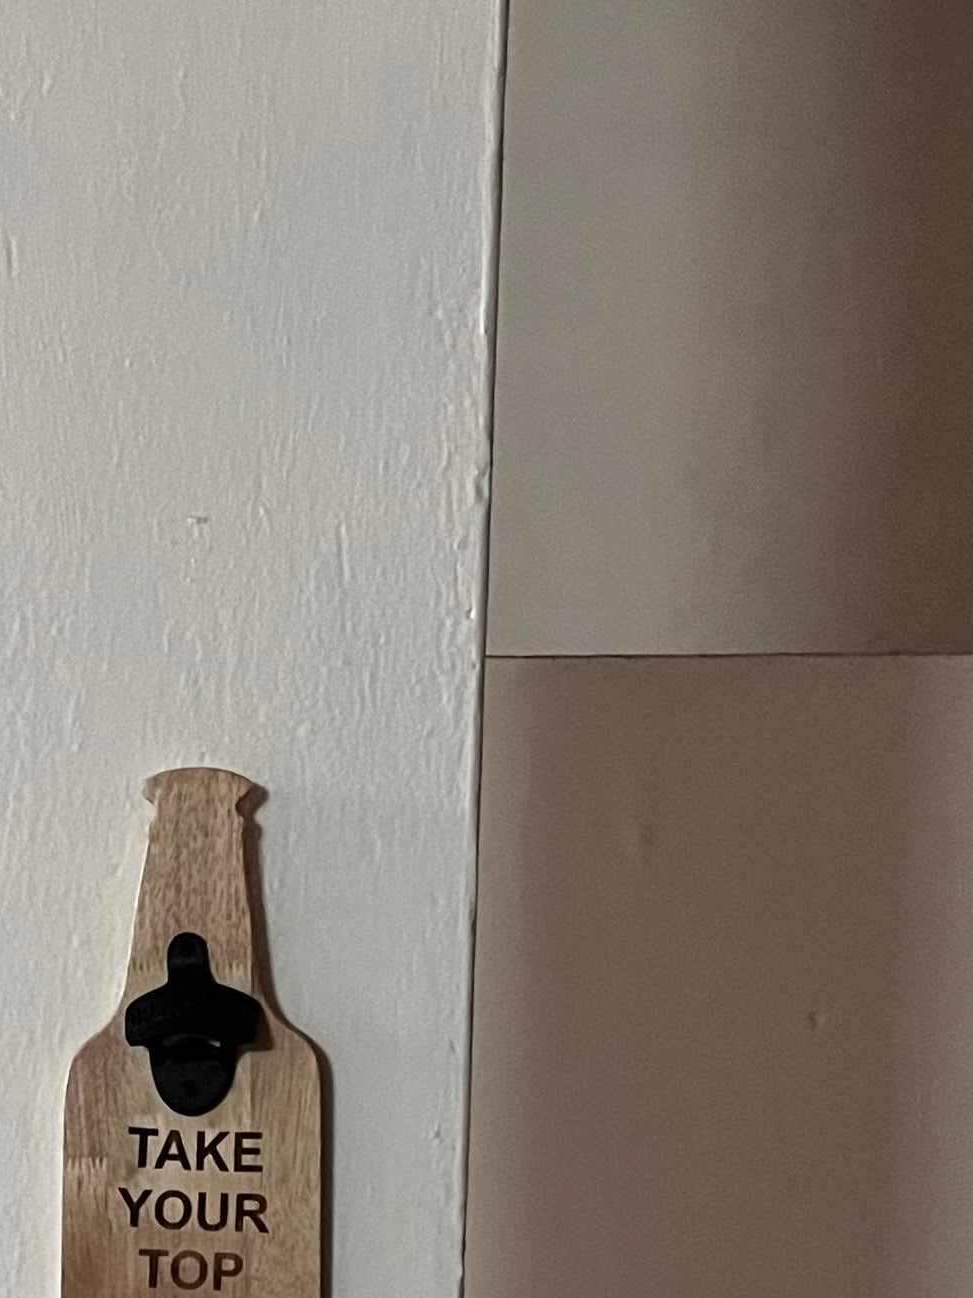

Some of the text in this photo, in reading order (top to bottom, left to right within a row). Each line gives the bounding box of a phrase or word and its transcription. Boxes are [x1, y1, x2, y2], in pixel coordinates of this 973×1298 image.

[128, 1127, 264, 1173] TAKE
[118, 1187, 270, 1234] YOUR
[139, 1249, 244, 1291] TOP
